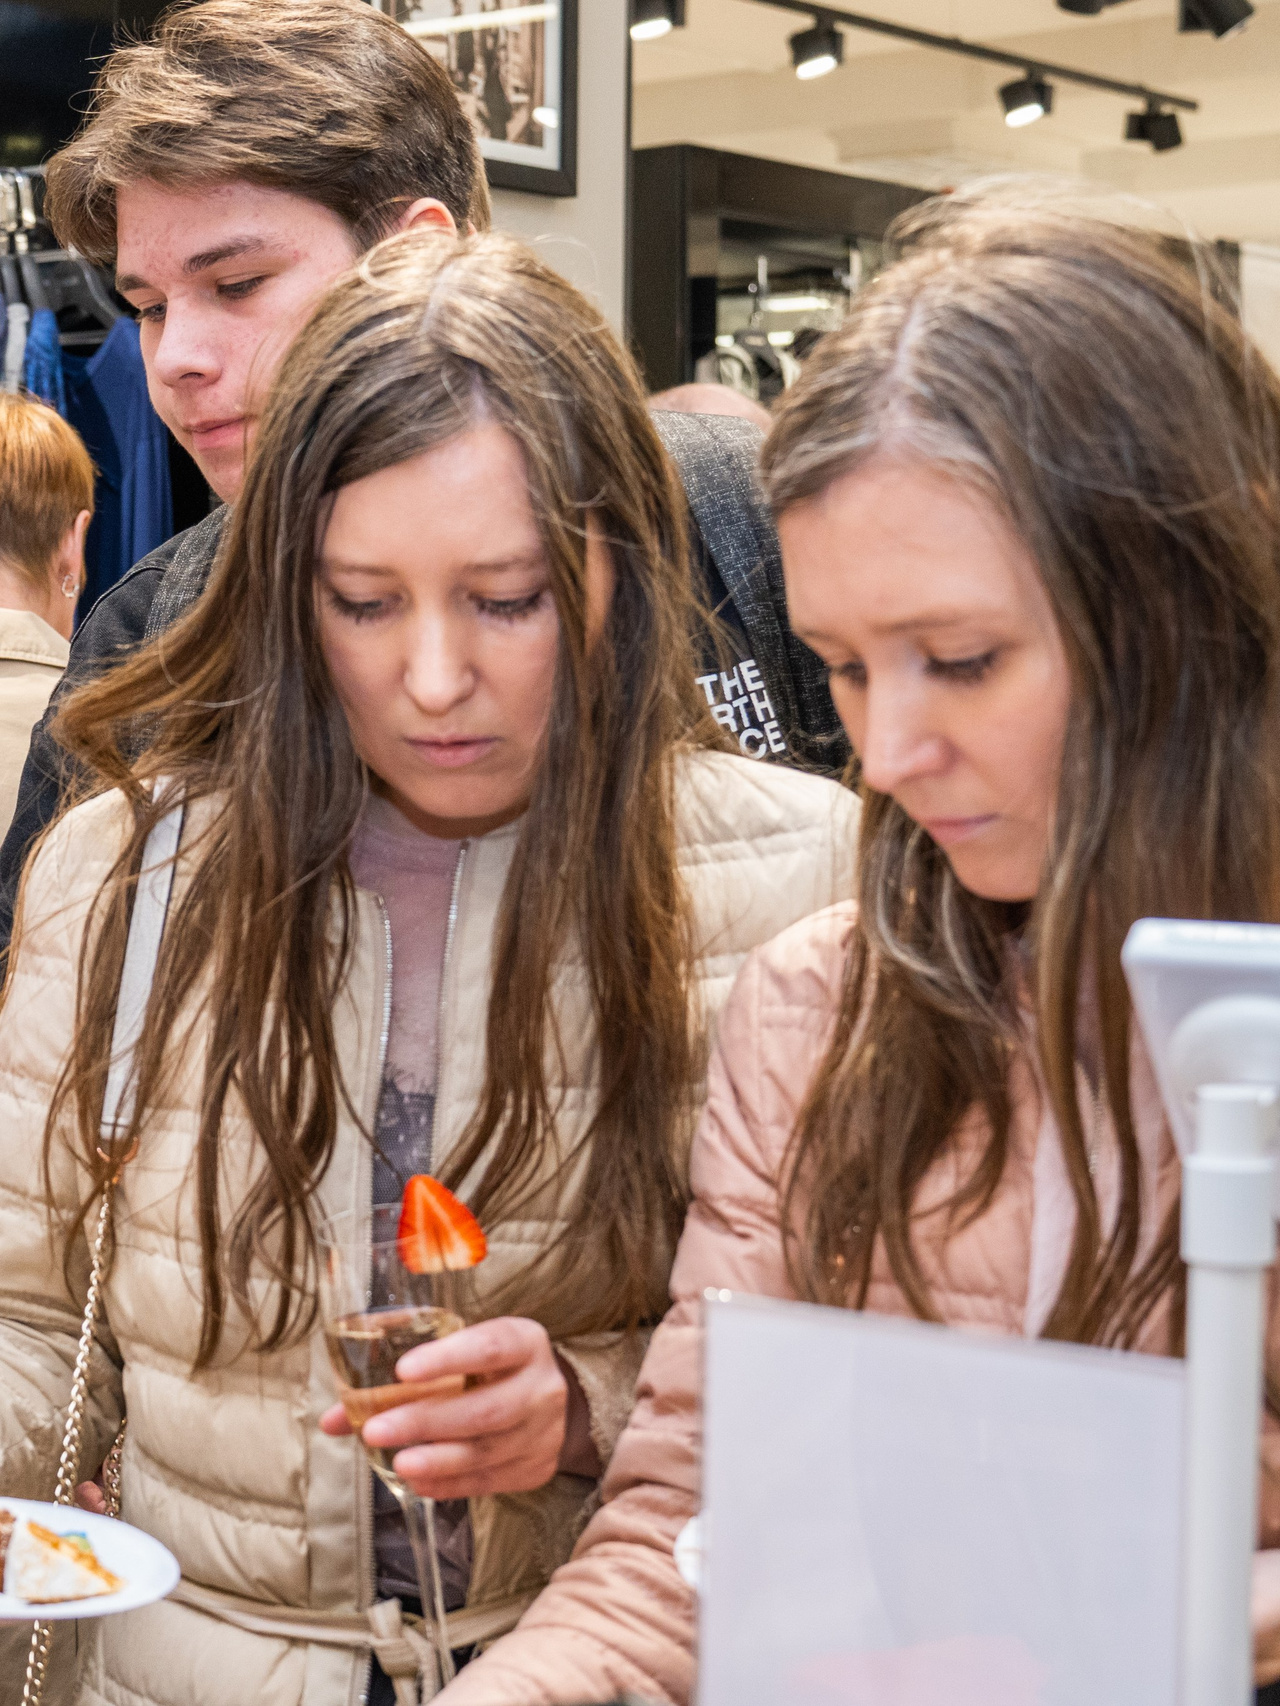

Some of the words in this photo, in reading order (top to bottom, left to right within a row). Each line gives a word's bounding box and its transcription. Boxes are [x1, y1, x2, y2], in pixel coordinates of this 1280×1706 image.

[694, 659, 765, 706] THE
[710, 690, 775, 733] RTH
[739, 720, 786, 760] CE
